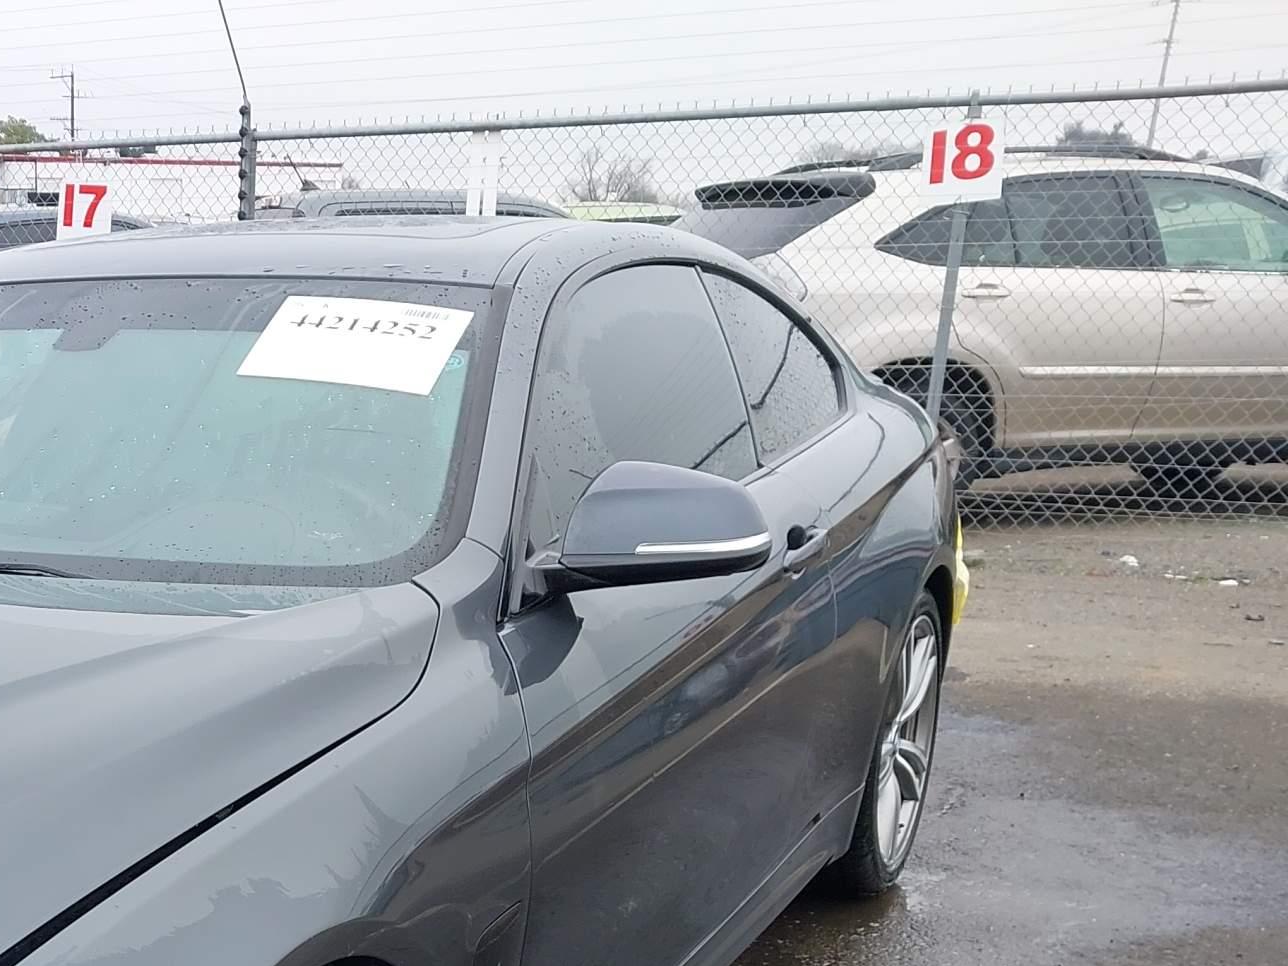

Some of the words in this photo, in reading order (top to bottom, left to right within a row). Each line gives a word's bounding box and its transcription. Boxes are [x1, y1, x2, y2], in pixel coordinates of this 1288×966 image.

[928, 123, 995, 185] 18
[62, 183, 108, 229] 17
[289, 313, 438, 340] 44214252
